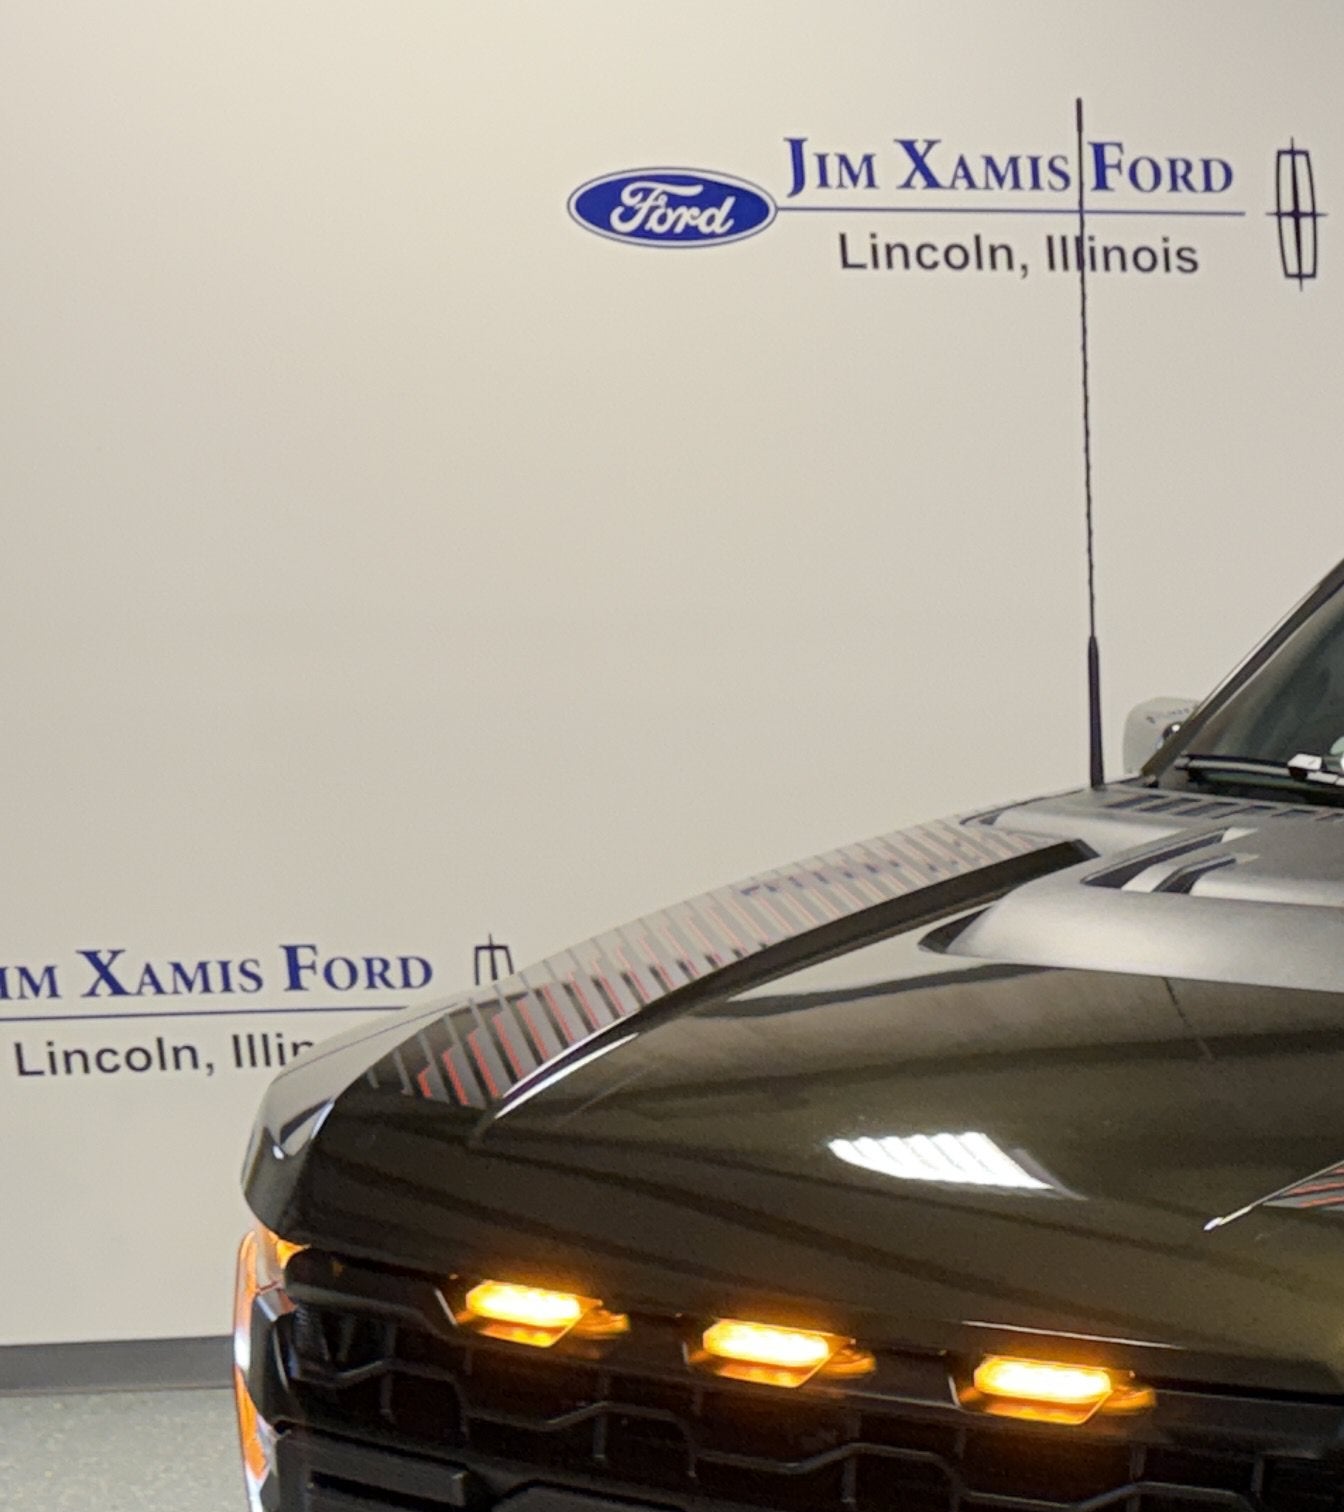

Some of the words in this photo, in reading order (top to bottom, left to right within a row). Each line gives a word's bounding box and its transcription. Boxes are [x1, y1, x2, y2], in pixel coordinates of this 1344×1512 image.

[783, 137, 877, 198] JIM
[894, 138, 1072, 192] XAMIS
[1087, 141, 1234, 194] FORD
[839, 232, 1029, 279] Lincoln,
[1046, 234, 1200, 274] Illinois
[0, 965, 61, 1000] IM
[75, 949, 263, 998] XAMIS
[279, 943, 434, 992] FORD
[14, 1036, 215, 1077] Lincoln,
[230, 1033, 314, 1068] Illi
